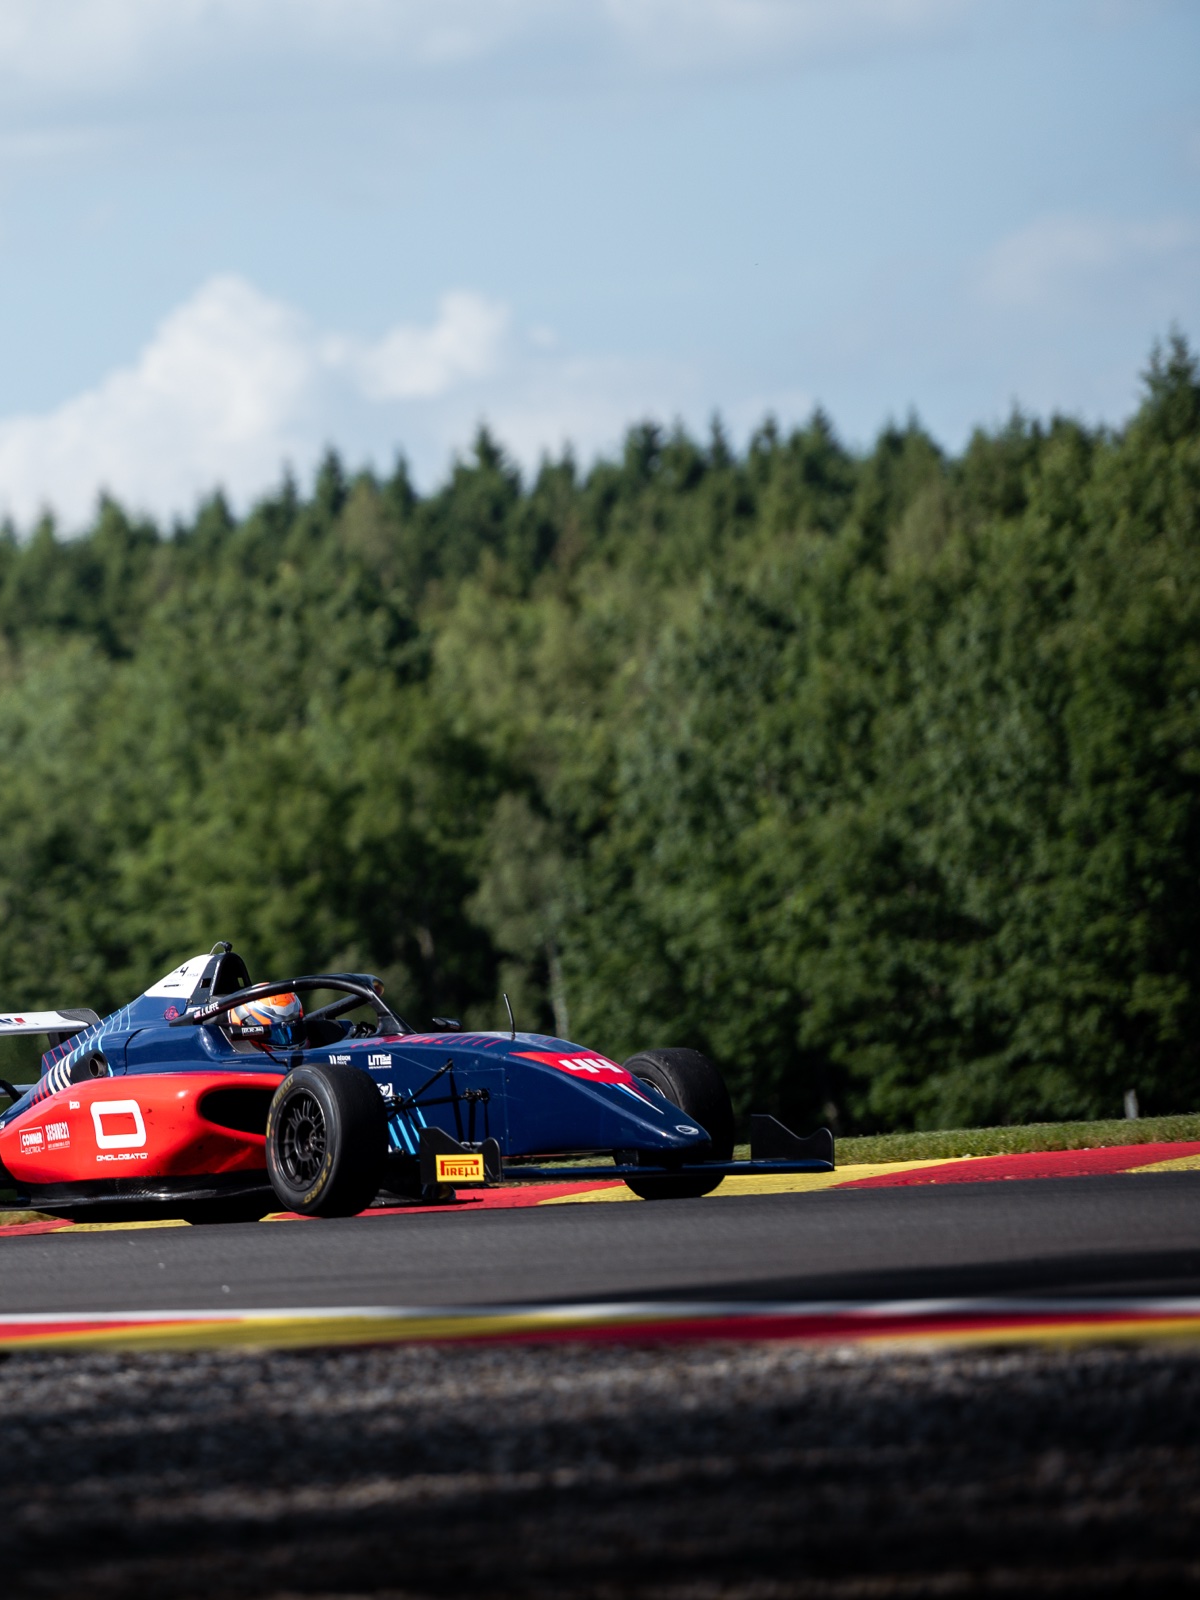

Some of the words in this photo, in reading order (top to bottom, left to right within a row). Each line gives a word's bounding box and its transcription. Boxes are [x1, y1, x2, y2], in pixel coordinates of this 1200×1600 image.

[558, 1058, 625, 1074] 44
[96, 1152, 147, 1162] OMOLOGATO
[439, 1159, 480, 1177] PIRELLI
